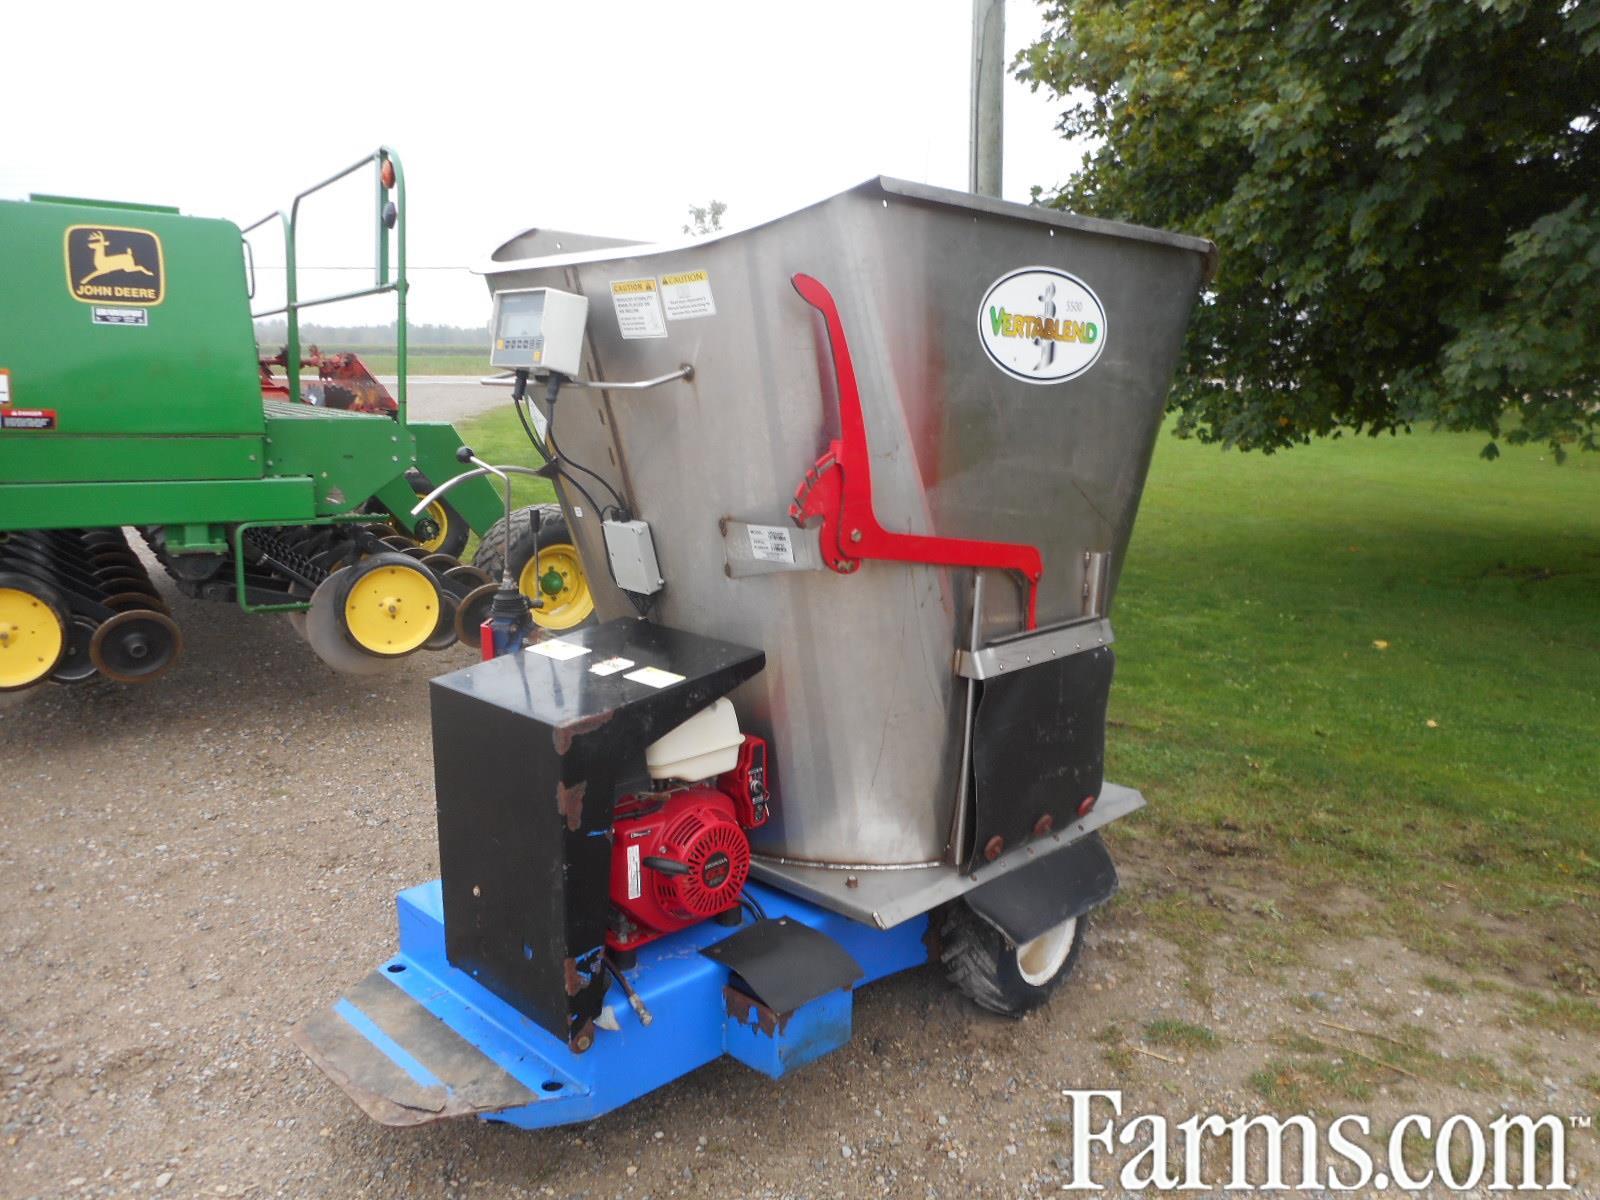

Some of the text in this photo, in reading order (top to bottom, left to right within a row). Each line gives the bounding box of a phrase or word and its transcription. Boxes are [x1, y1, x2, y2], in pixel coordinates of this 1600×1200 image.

[668, 273, 703, 284] CAUTION
[77, 285, 156, 299] JOHN DEERE
[613, 283, 643, 293] CAUTION
